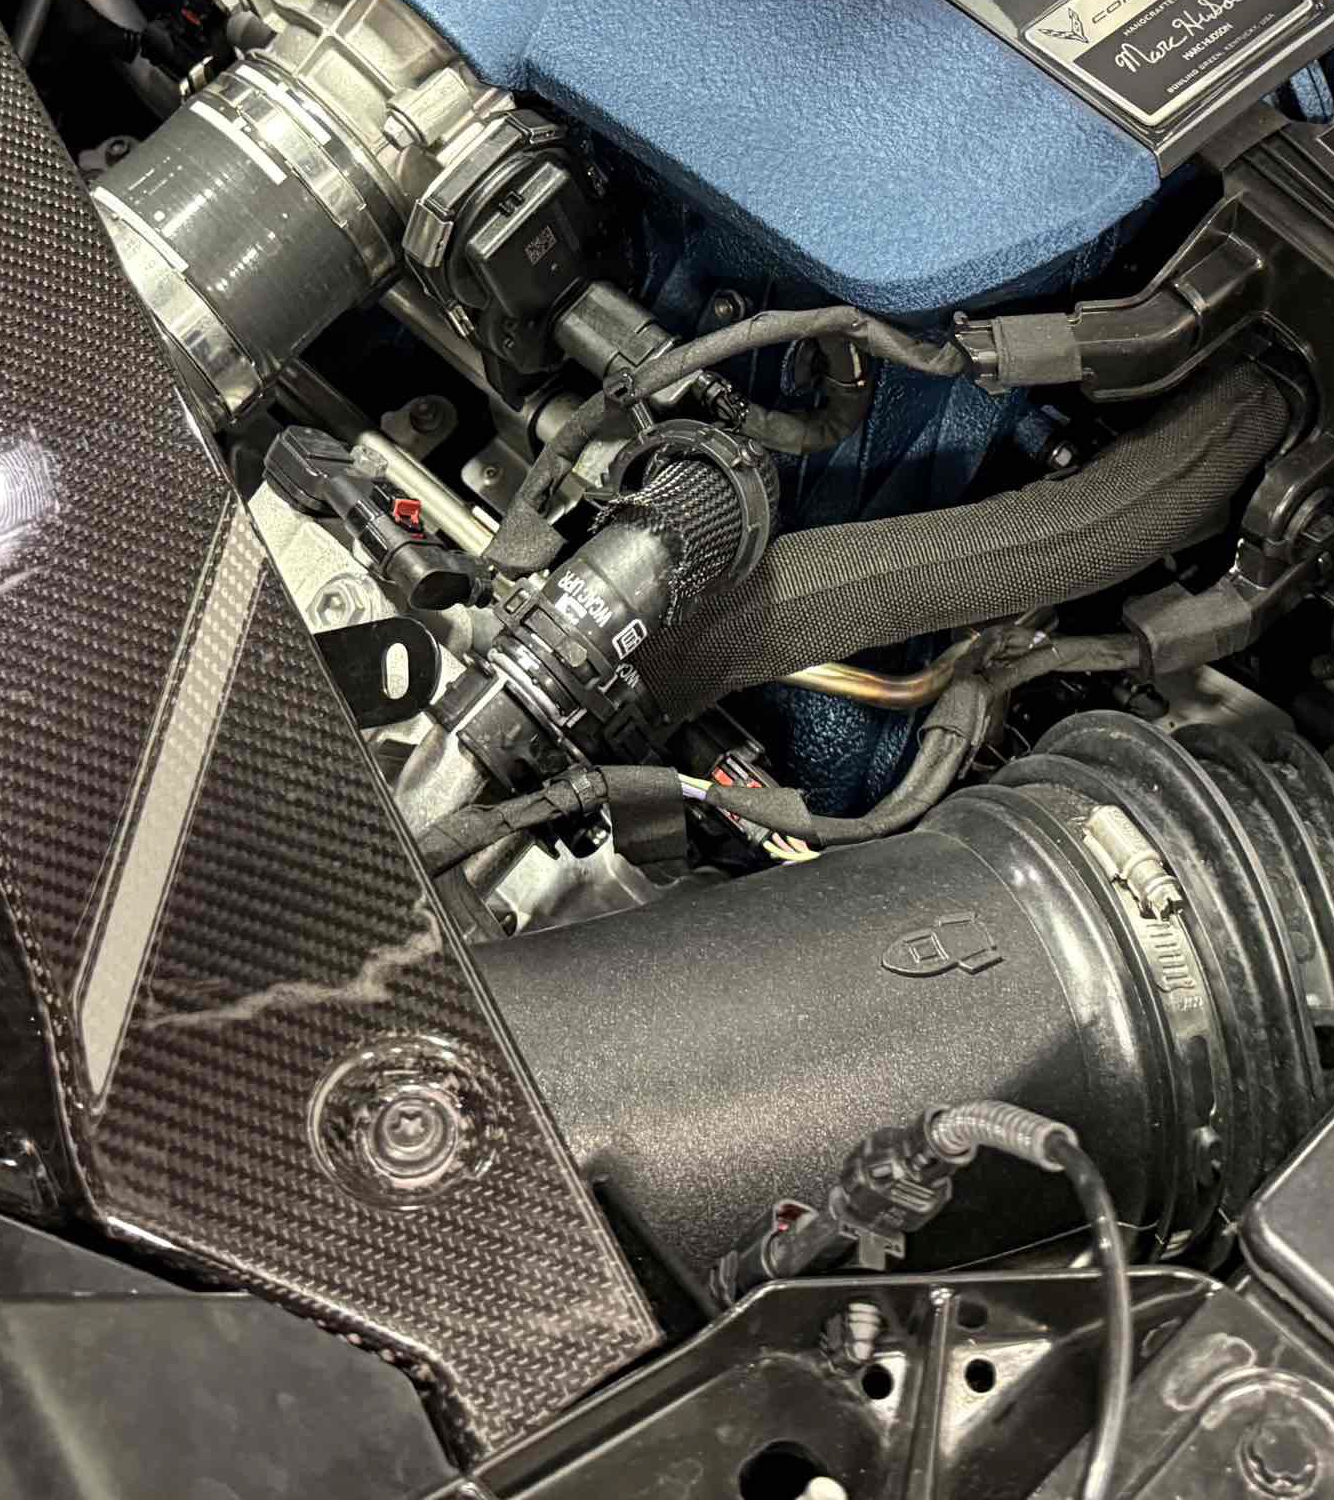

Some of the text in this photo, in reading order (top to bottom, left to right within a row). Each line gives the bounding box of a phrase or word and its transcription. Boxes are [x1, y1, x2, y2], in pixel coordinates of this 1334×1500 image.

[1166, 68, 1200, 94] BOWLING
[1258, 12, 1275, 27] USA
[1181, 22, 1234, 61] MARC HUDSON
